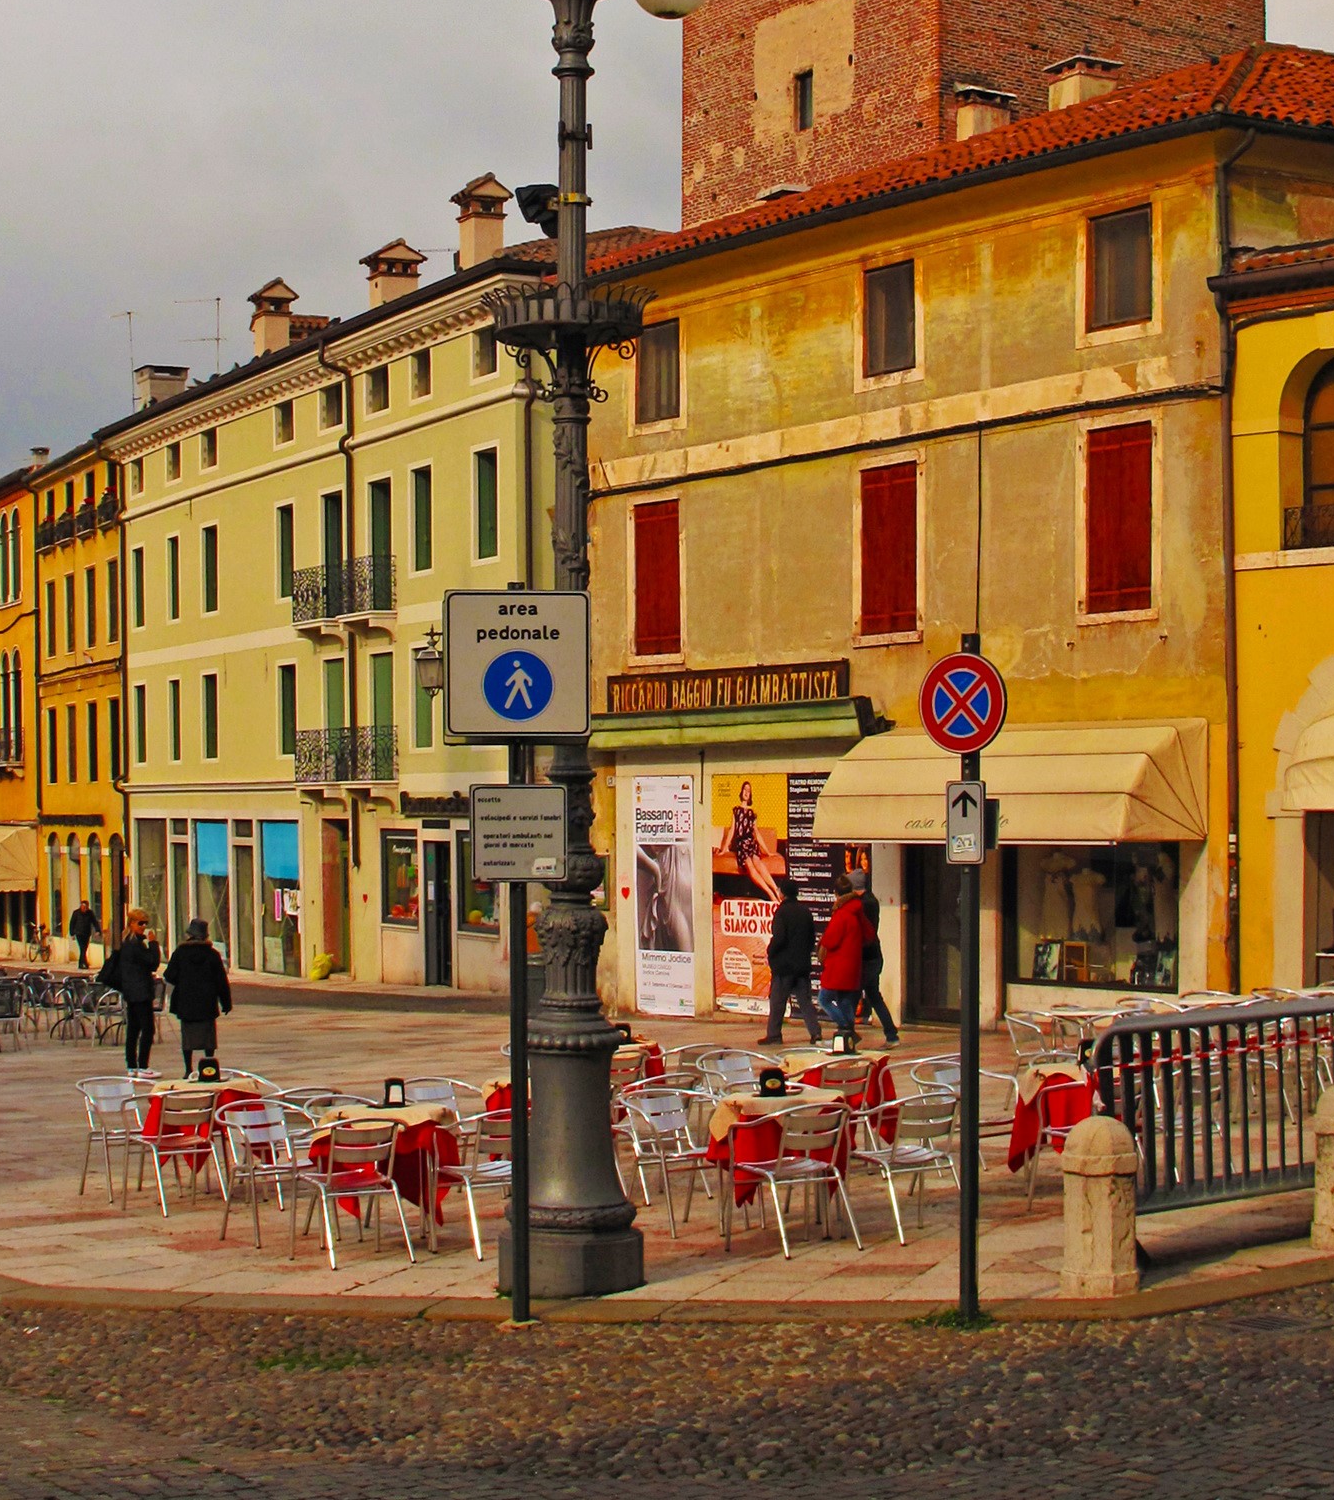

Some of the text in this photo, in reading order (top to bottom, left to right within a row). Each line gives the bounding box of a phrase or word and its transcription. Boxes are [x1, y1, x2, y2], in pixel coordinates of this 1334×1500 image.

[498, 604, 538, 616] area
[476, 625, 560, 643] pedonale
[613, 671, 838, 713] RICCARDO BAGGIO FU GIAMBATTISTA
[635, 808, 673, 820] Bassano
[635, 822, 674, 836] Fotografia
[905, 819, 934, 829] casa
[724, 901, 734, 916] IL
[724, 919, 758, 933] SIAMO
[642, 953, 691, 963] Mimmo Jodice
